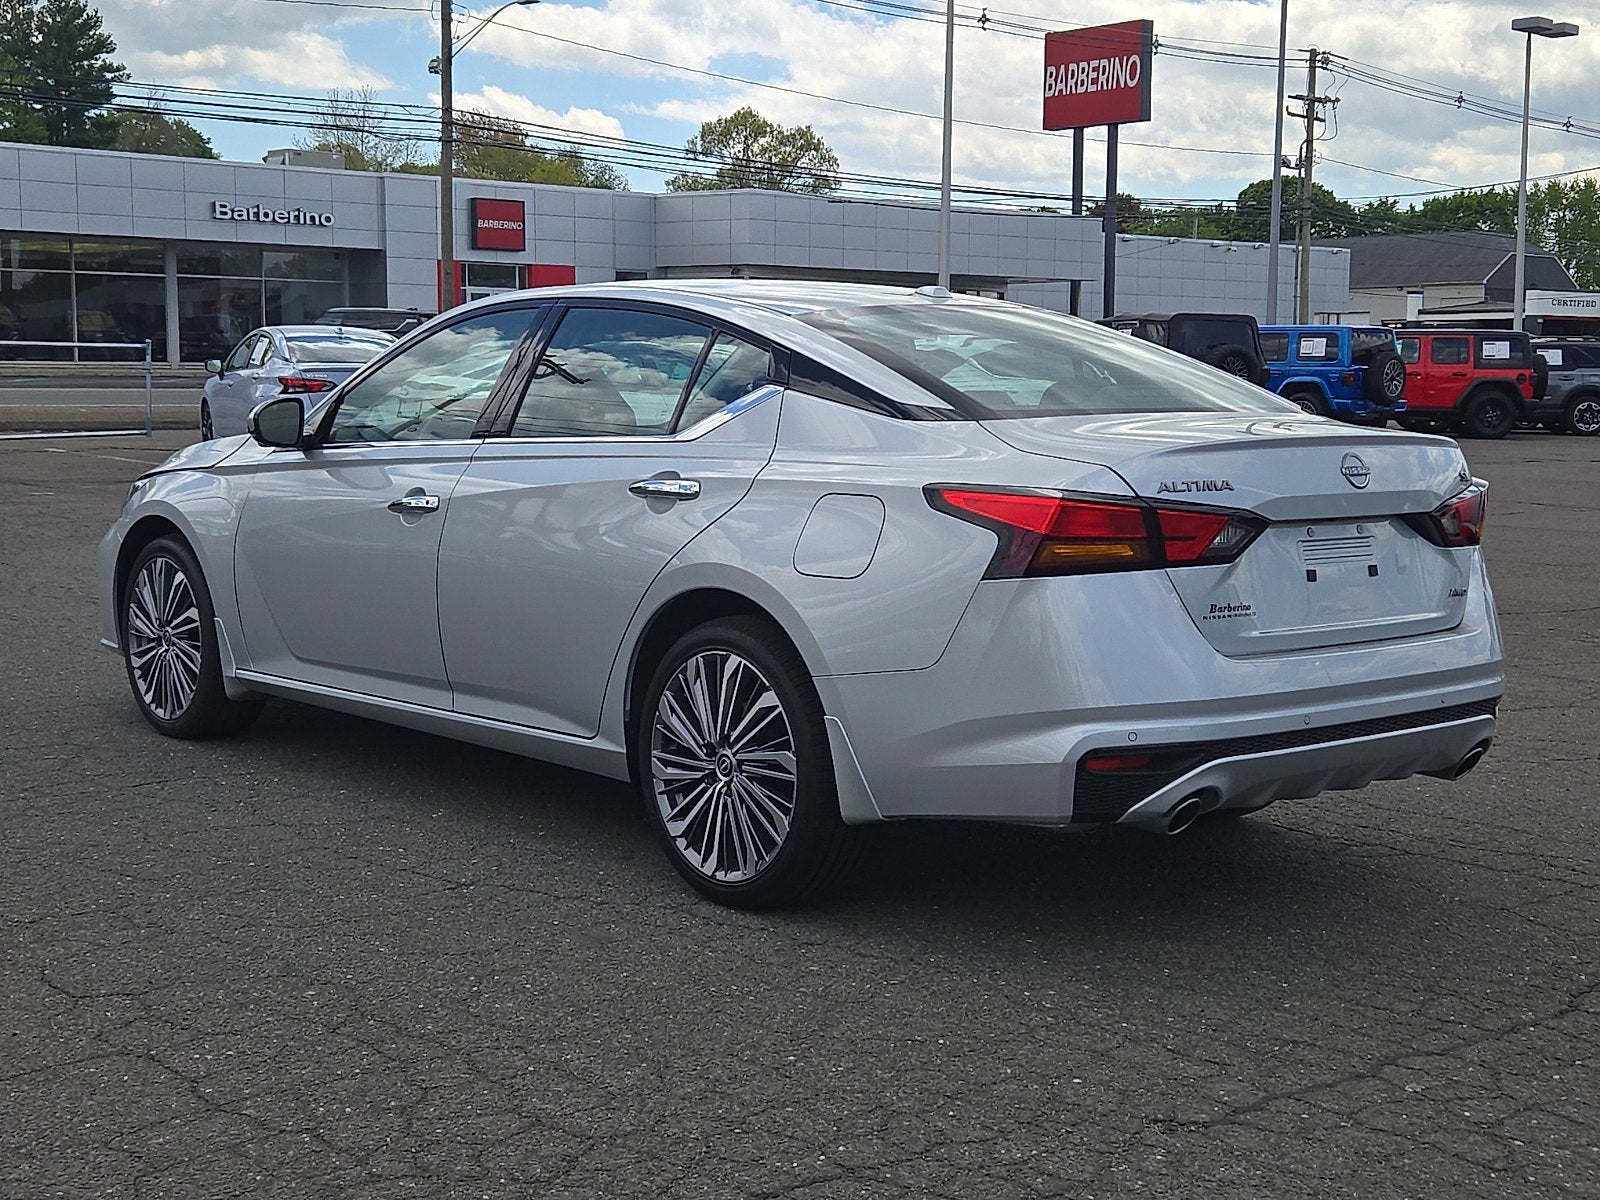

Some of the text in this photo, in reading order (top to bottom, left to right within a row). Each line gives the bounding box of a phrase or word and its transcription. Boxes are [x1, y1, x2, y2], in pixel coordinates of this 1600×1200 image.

[1044, 54, 1141, 98] BARBERINO
[213, 200, 335, 226] Barberino
[477, 219, 524, 230] BARBERINO
[1551, 298, 1597, 308] CERTIFIED
[1157, 479, 1235, 494] ALTIMA
[1209, 602, 1252, 614] Barberino
